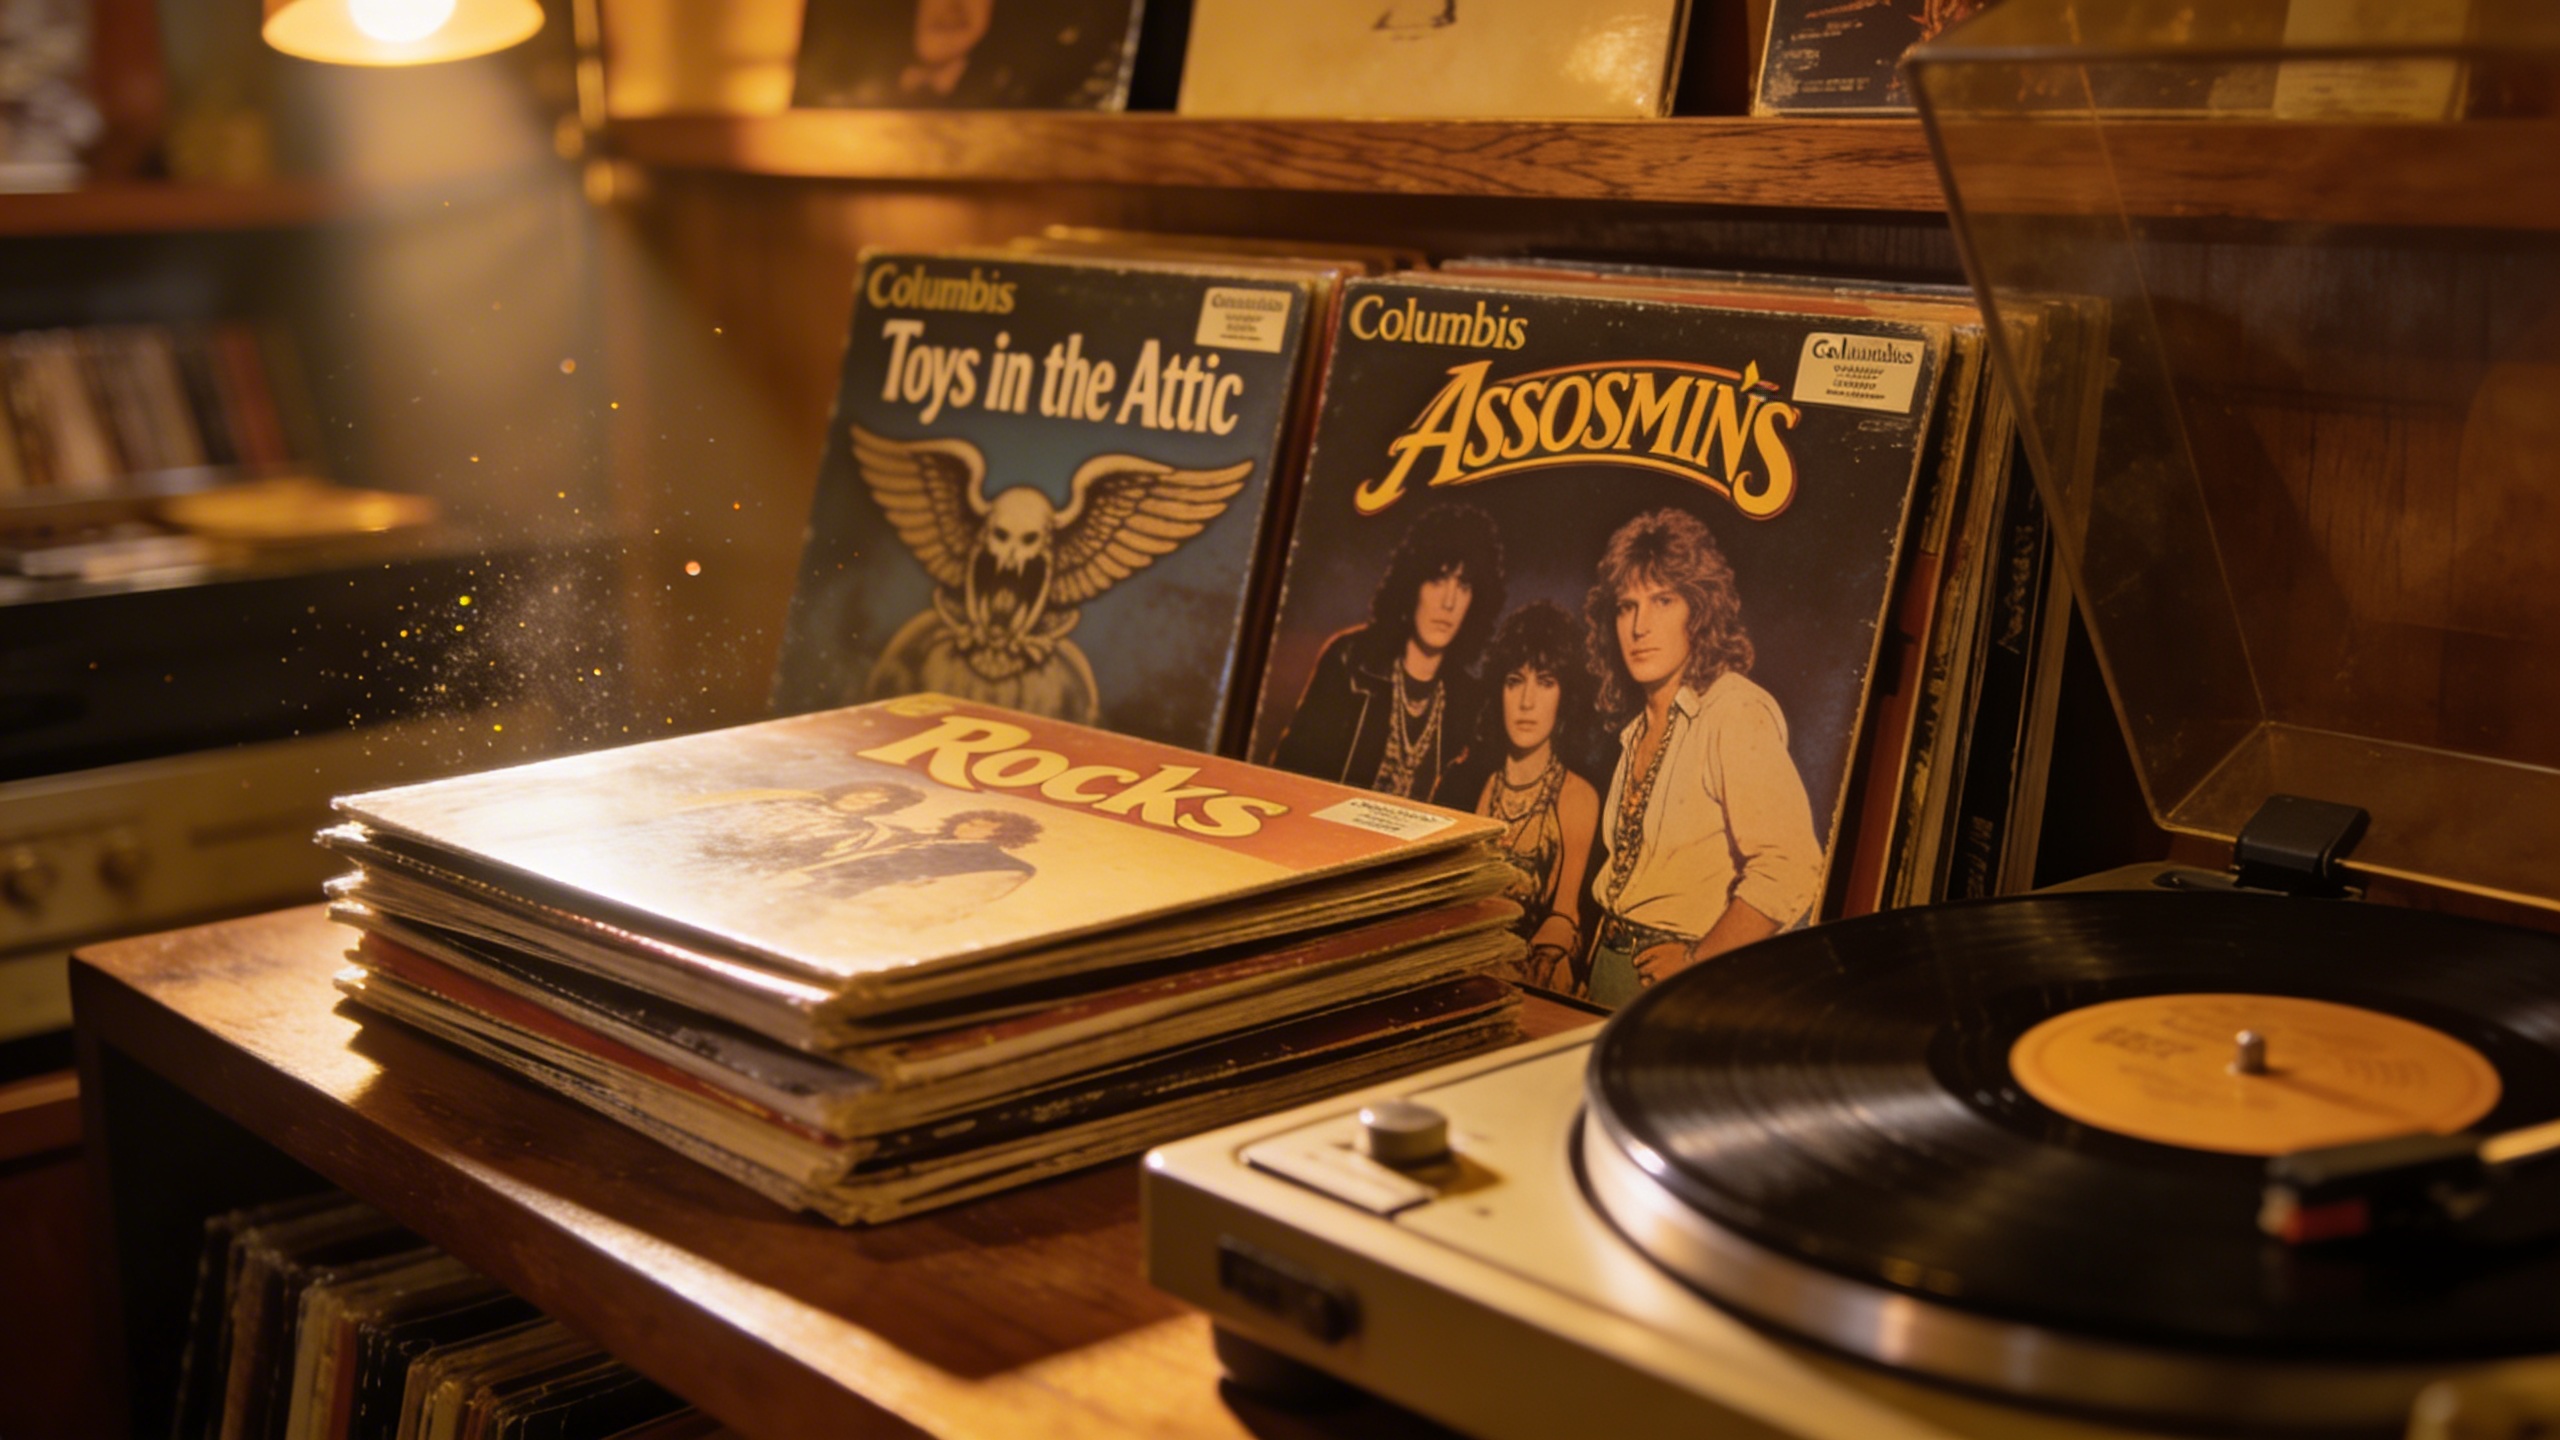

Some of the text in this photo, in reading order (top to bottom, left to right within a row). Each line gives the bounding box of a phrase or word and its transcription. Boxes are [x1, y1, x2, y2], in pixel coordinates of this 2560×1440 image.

[867, 263, 1018, 314] Columbis
[1349, 294, 1529, 350] Columbis
[881, 318, 1245, 435] Toys in the Attic
